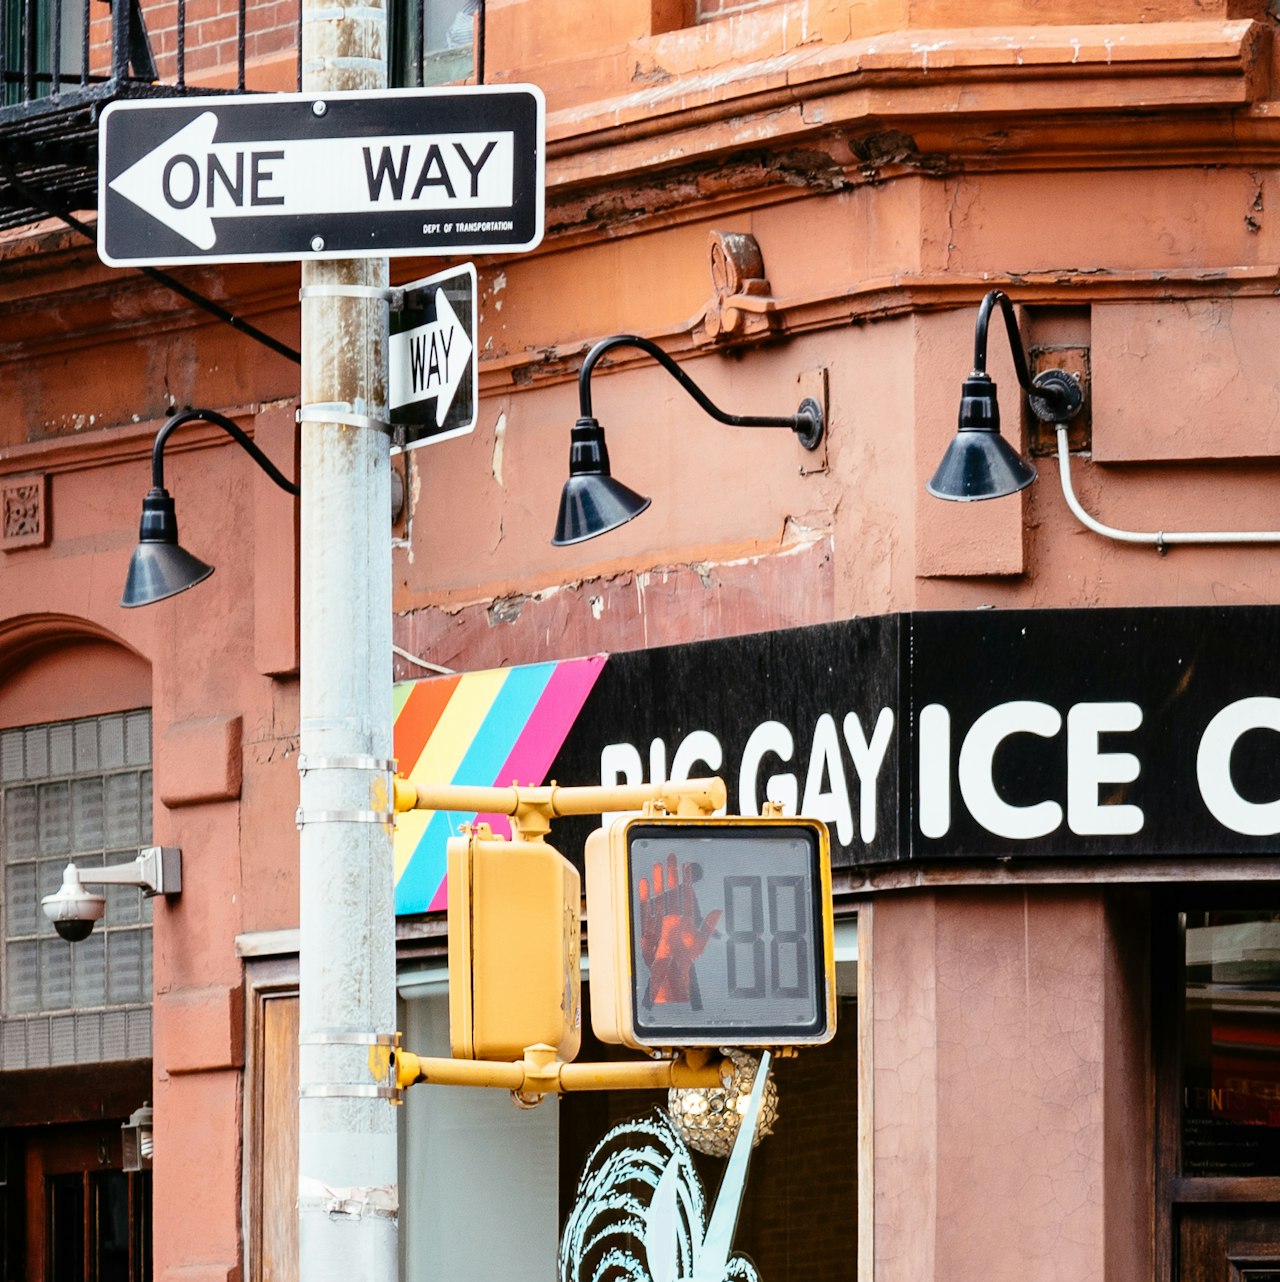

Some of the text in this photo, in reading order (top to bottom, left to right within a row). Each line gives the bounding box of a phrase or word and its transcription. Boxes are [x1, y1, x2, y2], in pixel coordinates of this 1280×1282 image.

[161, 141, 498, 210] ONE WAY
[443, 223, 453, 233] OF
[455, 221, 513, 232] TRANSPORTATION
[409, 325, 454, 393] WAY
[738, 706, 895, 847] GAY
[919, 700, 1144, 840] ICE
